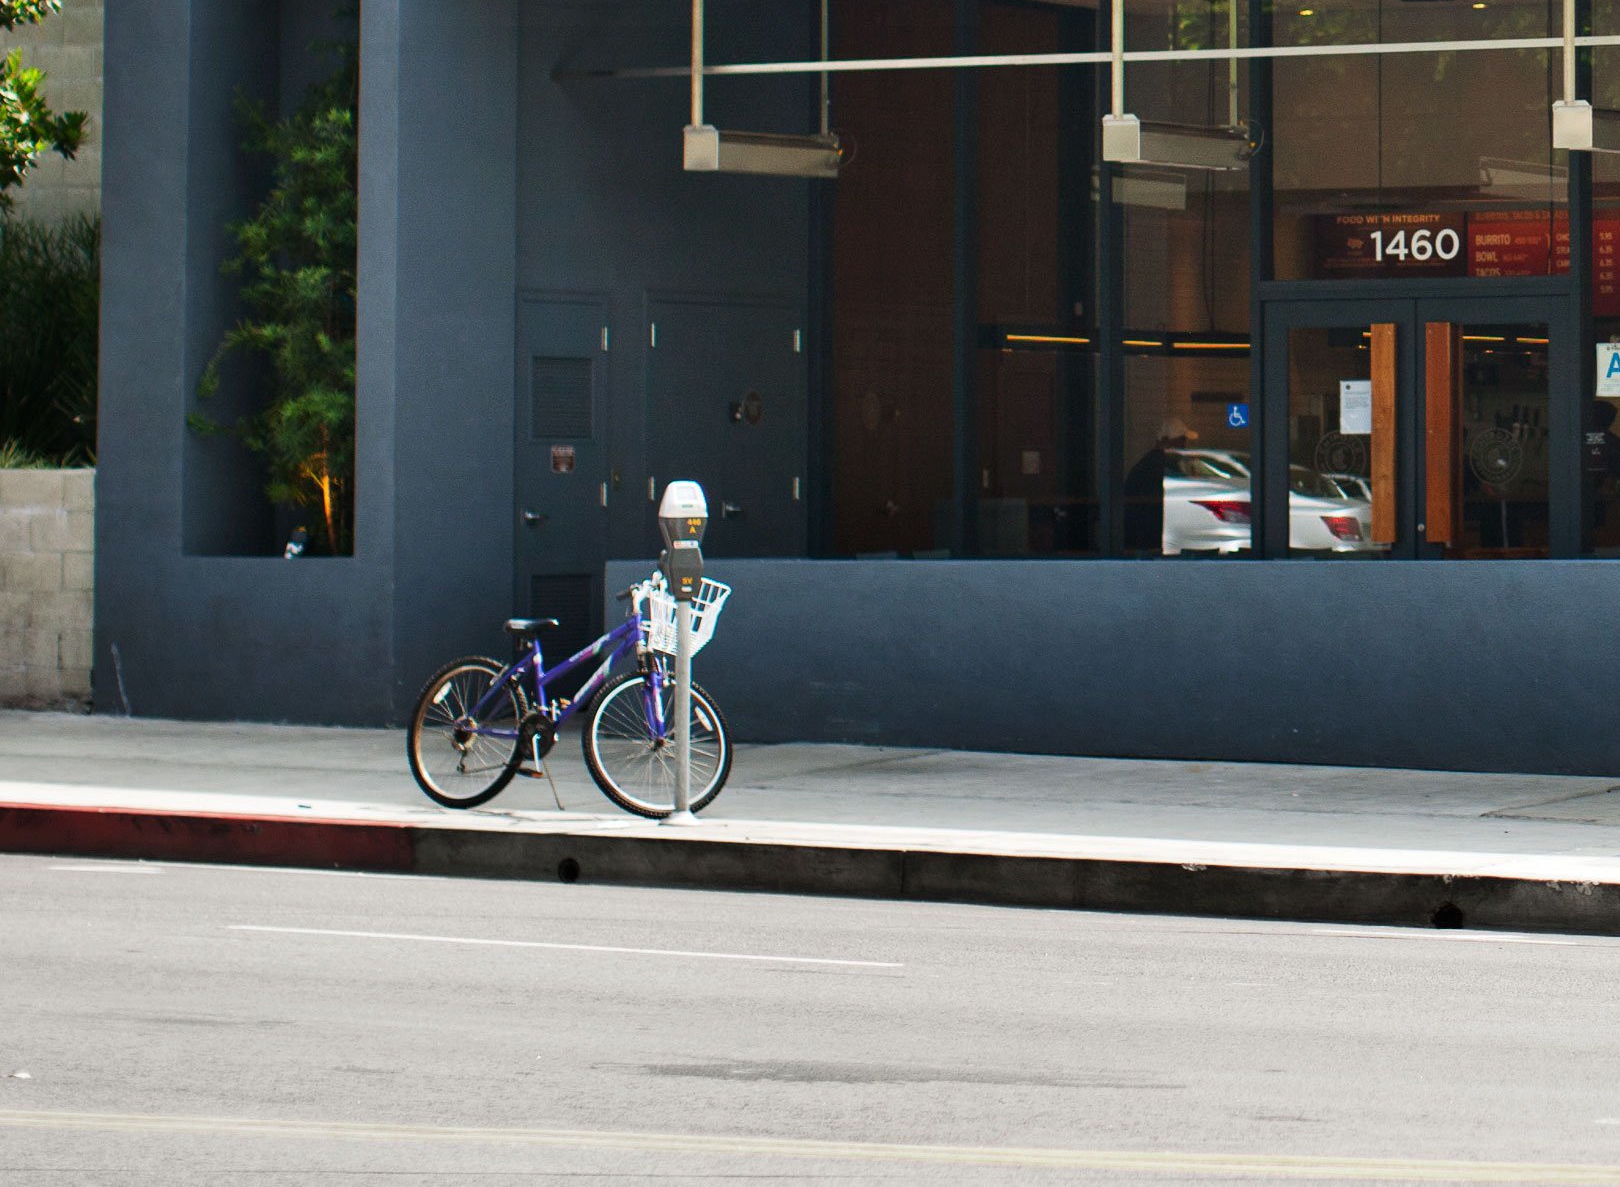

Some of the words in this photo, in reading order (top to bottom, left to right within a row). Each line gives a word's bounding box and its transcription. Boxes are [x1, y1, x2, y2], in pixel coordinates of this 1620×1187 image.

[1336, 215, 1364, 225] FOOD
[1391, 214, 1441, 224] INTEGRITY
[1369, 228, 1460, 262] 1460
[1475, 233, 1511, 246] BURRITO
[1475, 250, 1498, 263] BOWL
